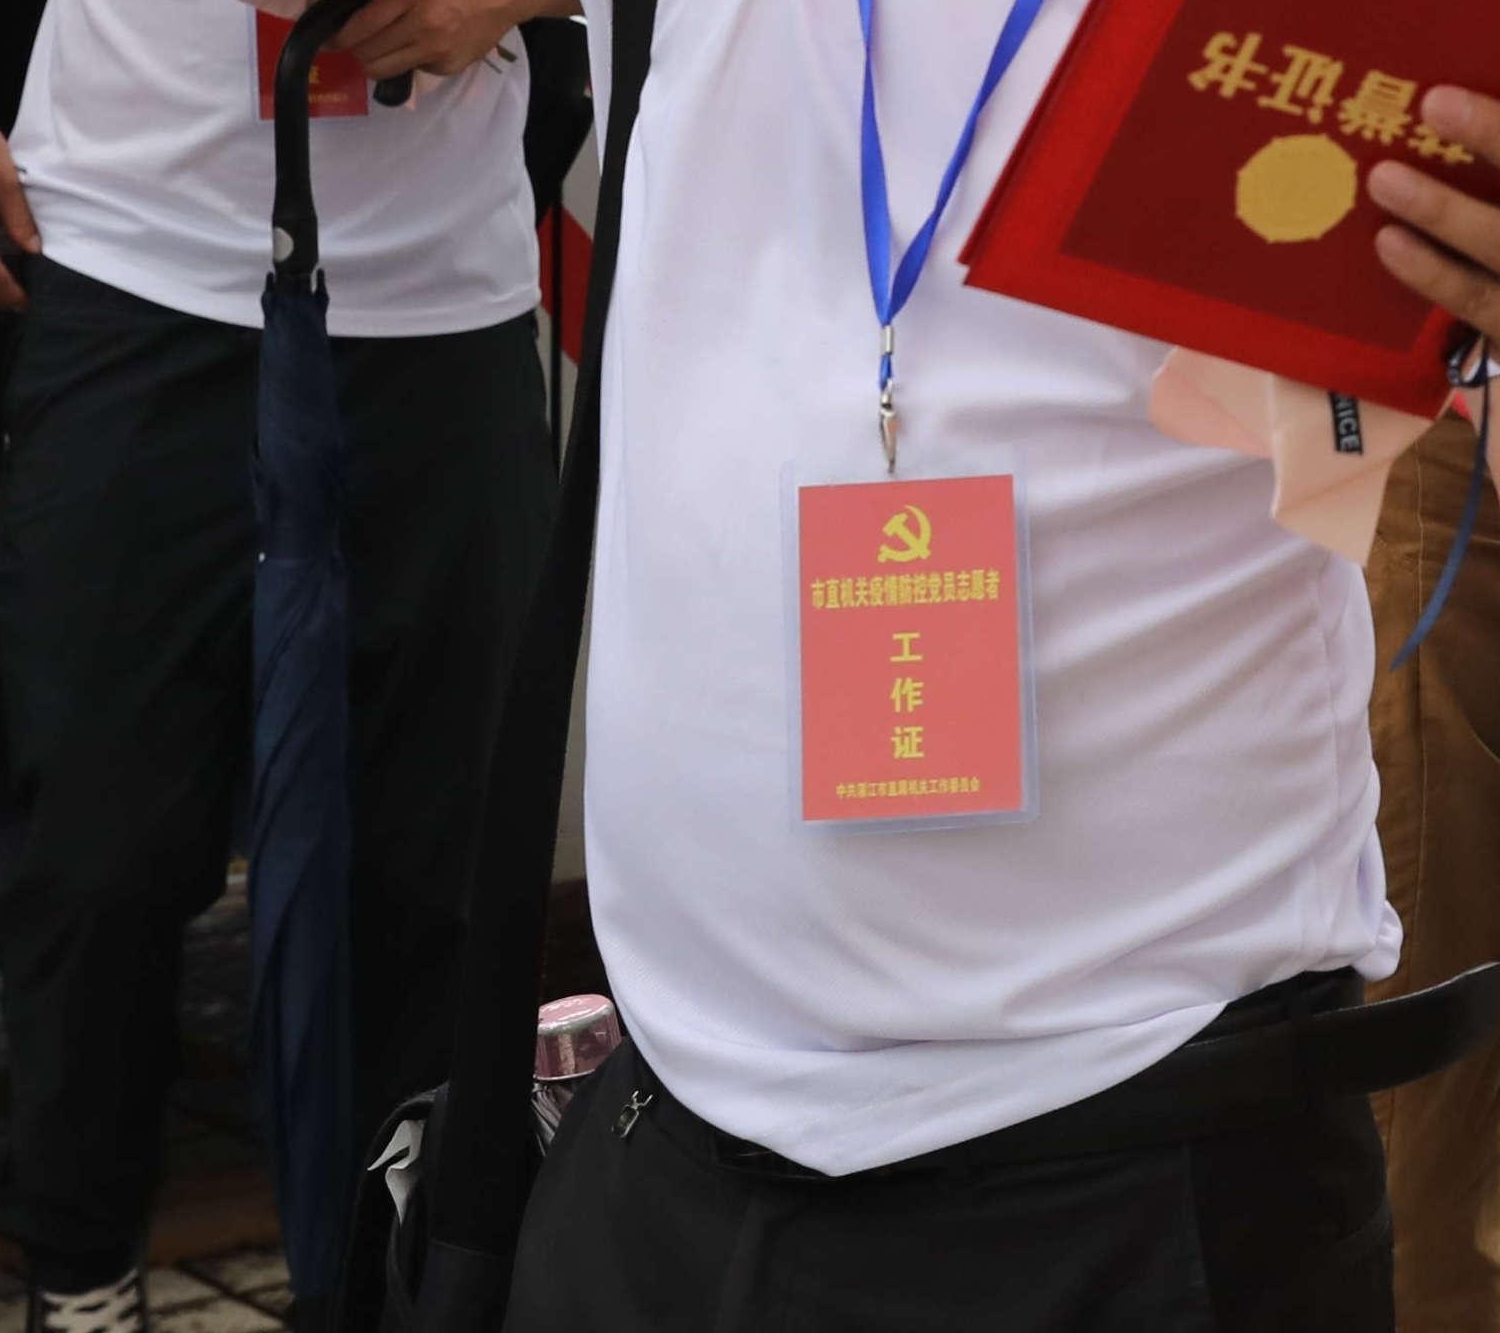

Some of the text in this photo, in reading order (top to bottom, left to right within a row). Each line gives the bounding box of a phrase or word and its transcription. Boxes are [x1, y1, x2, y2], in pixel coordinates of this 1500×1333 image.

[811, 568, 1001, 609] 市直机关疫情防控党员志愿者
[890, 631, 925, 760] 工作证
